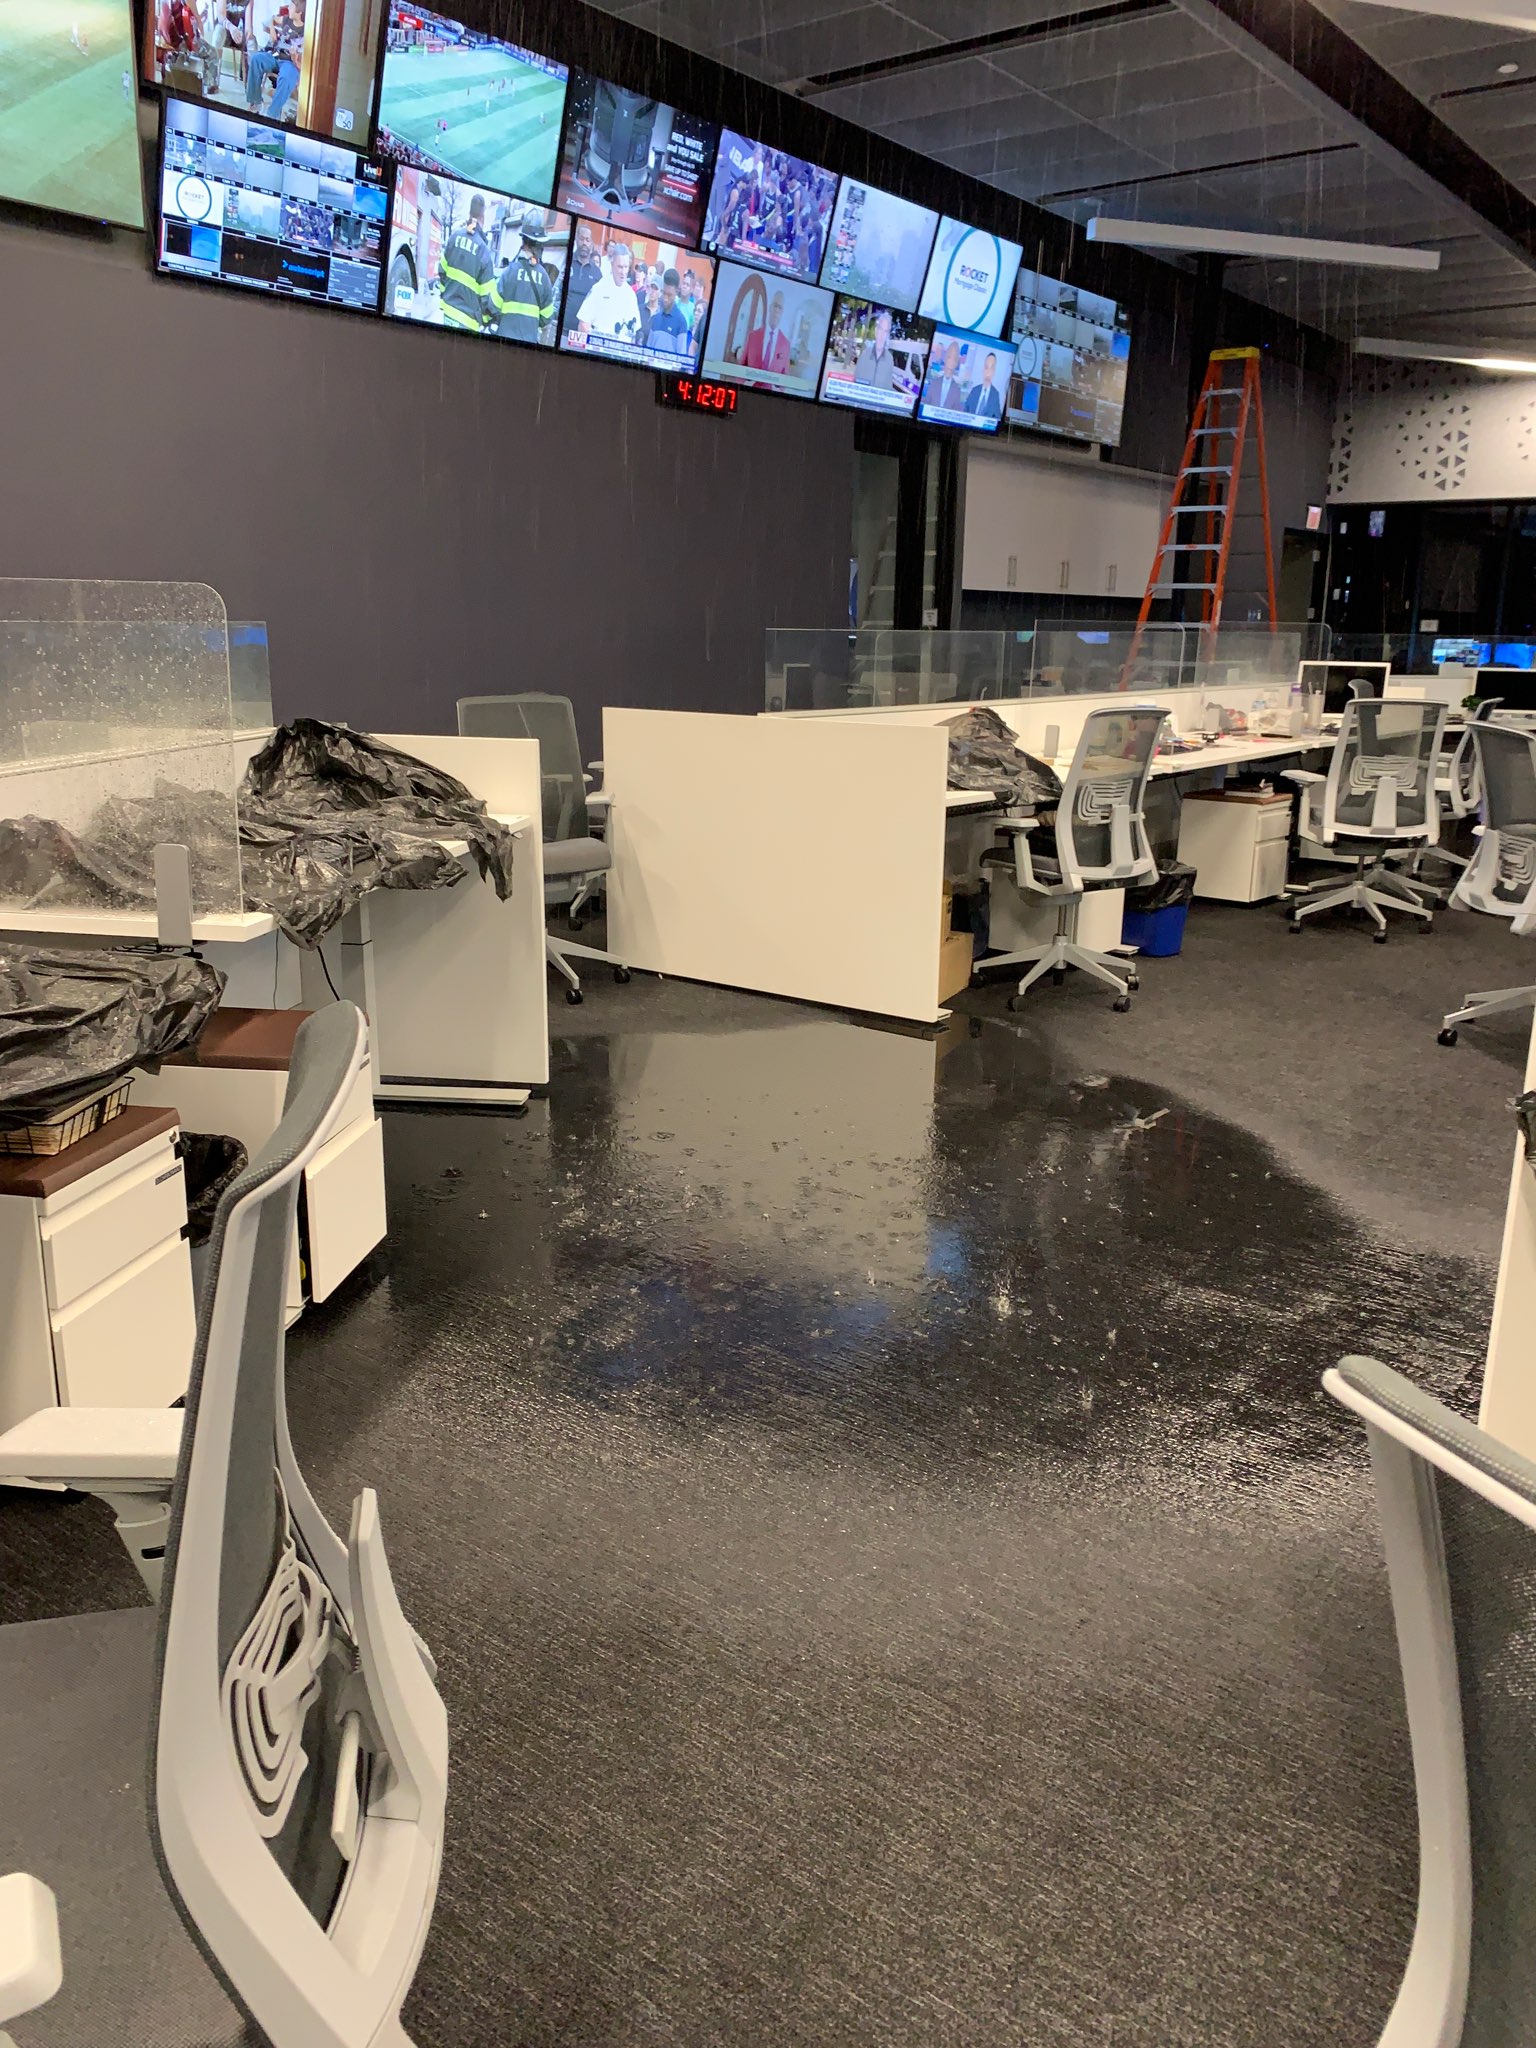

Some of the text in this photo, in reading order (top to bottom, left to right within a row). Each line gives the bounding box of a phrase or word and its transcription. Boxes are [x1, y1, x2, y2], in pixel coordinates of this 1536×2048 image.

[689, 150, 704, 163] SALE
[960, 264, 989, 283] ROCKET
[396, 289, 412, 301] FOX
[678, 380, 736, 410] 4:12:07
